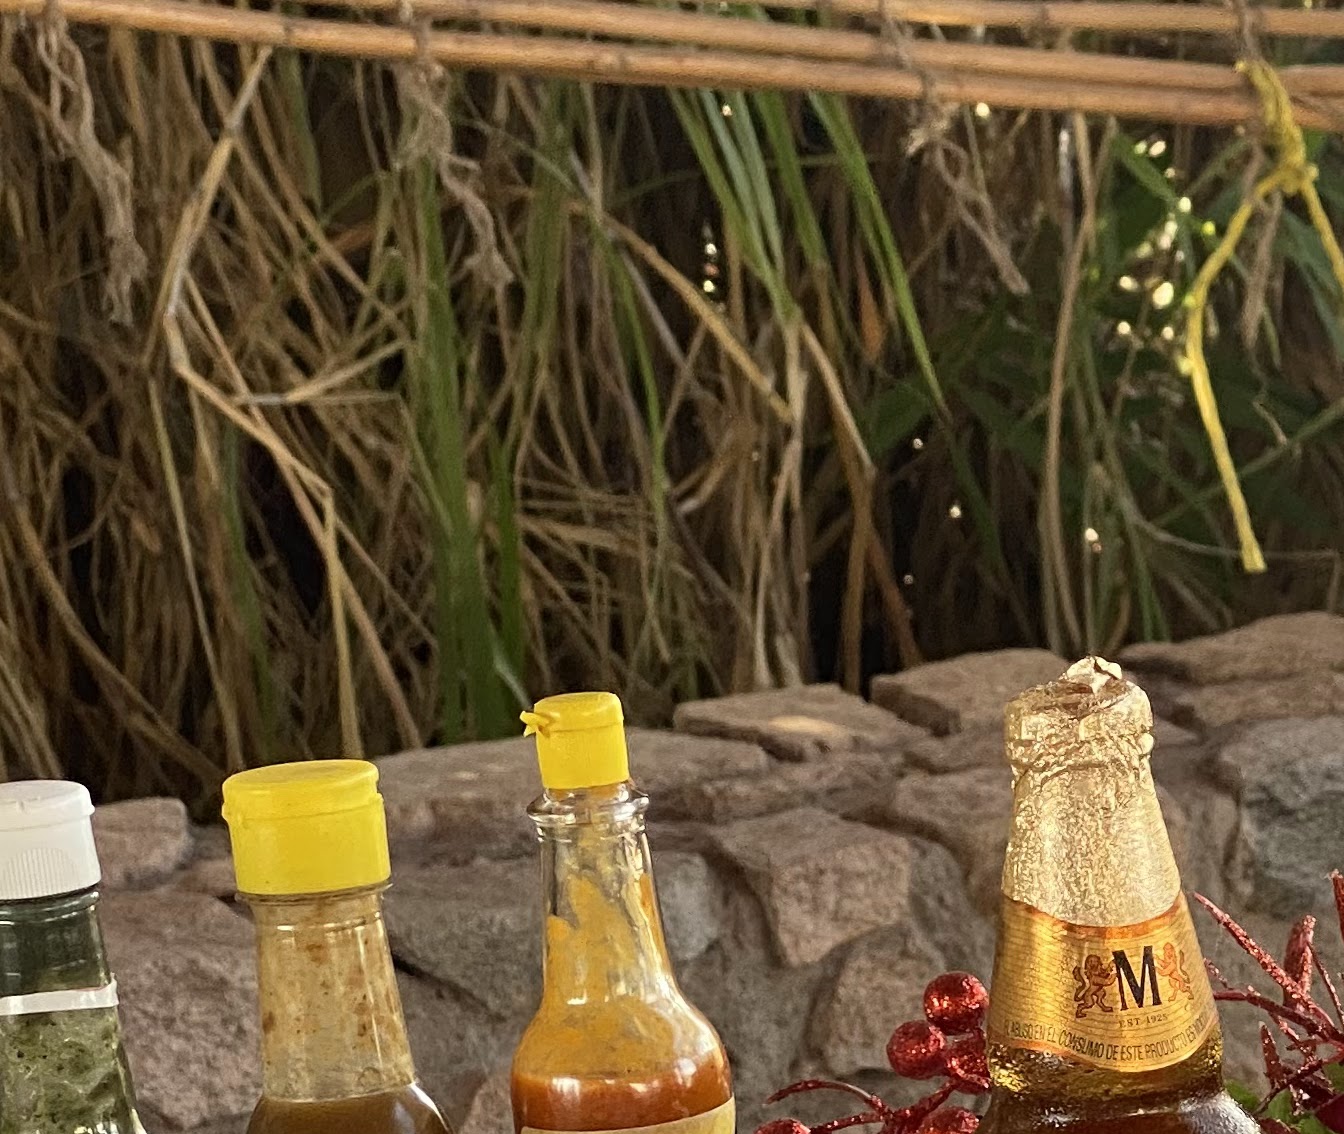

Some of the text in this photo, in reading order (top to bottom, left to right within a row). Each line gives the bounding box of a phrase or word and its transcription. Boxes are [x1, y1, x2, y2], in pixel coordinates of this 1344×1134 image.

[1112, 945, 1162, 1011] M
[1058, 1029, 1105, 1059] CONSUMO
[1106, 1044, 1119, 1060] DE
[1120, 1045, 1144, 1061] ESTE
[1144, 1031, 1187, 1059] PRODUCTO
